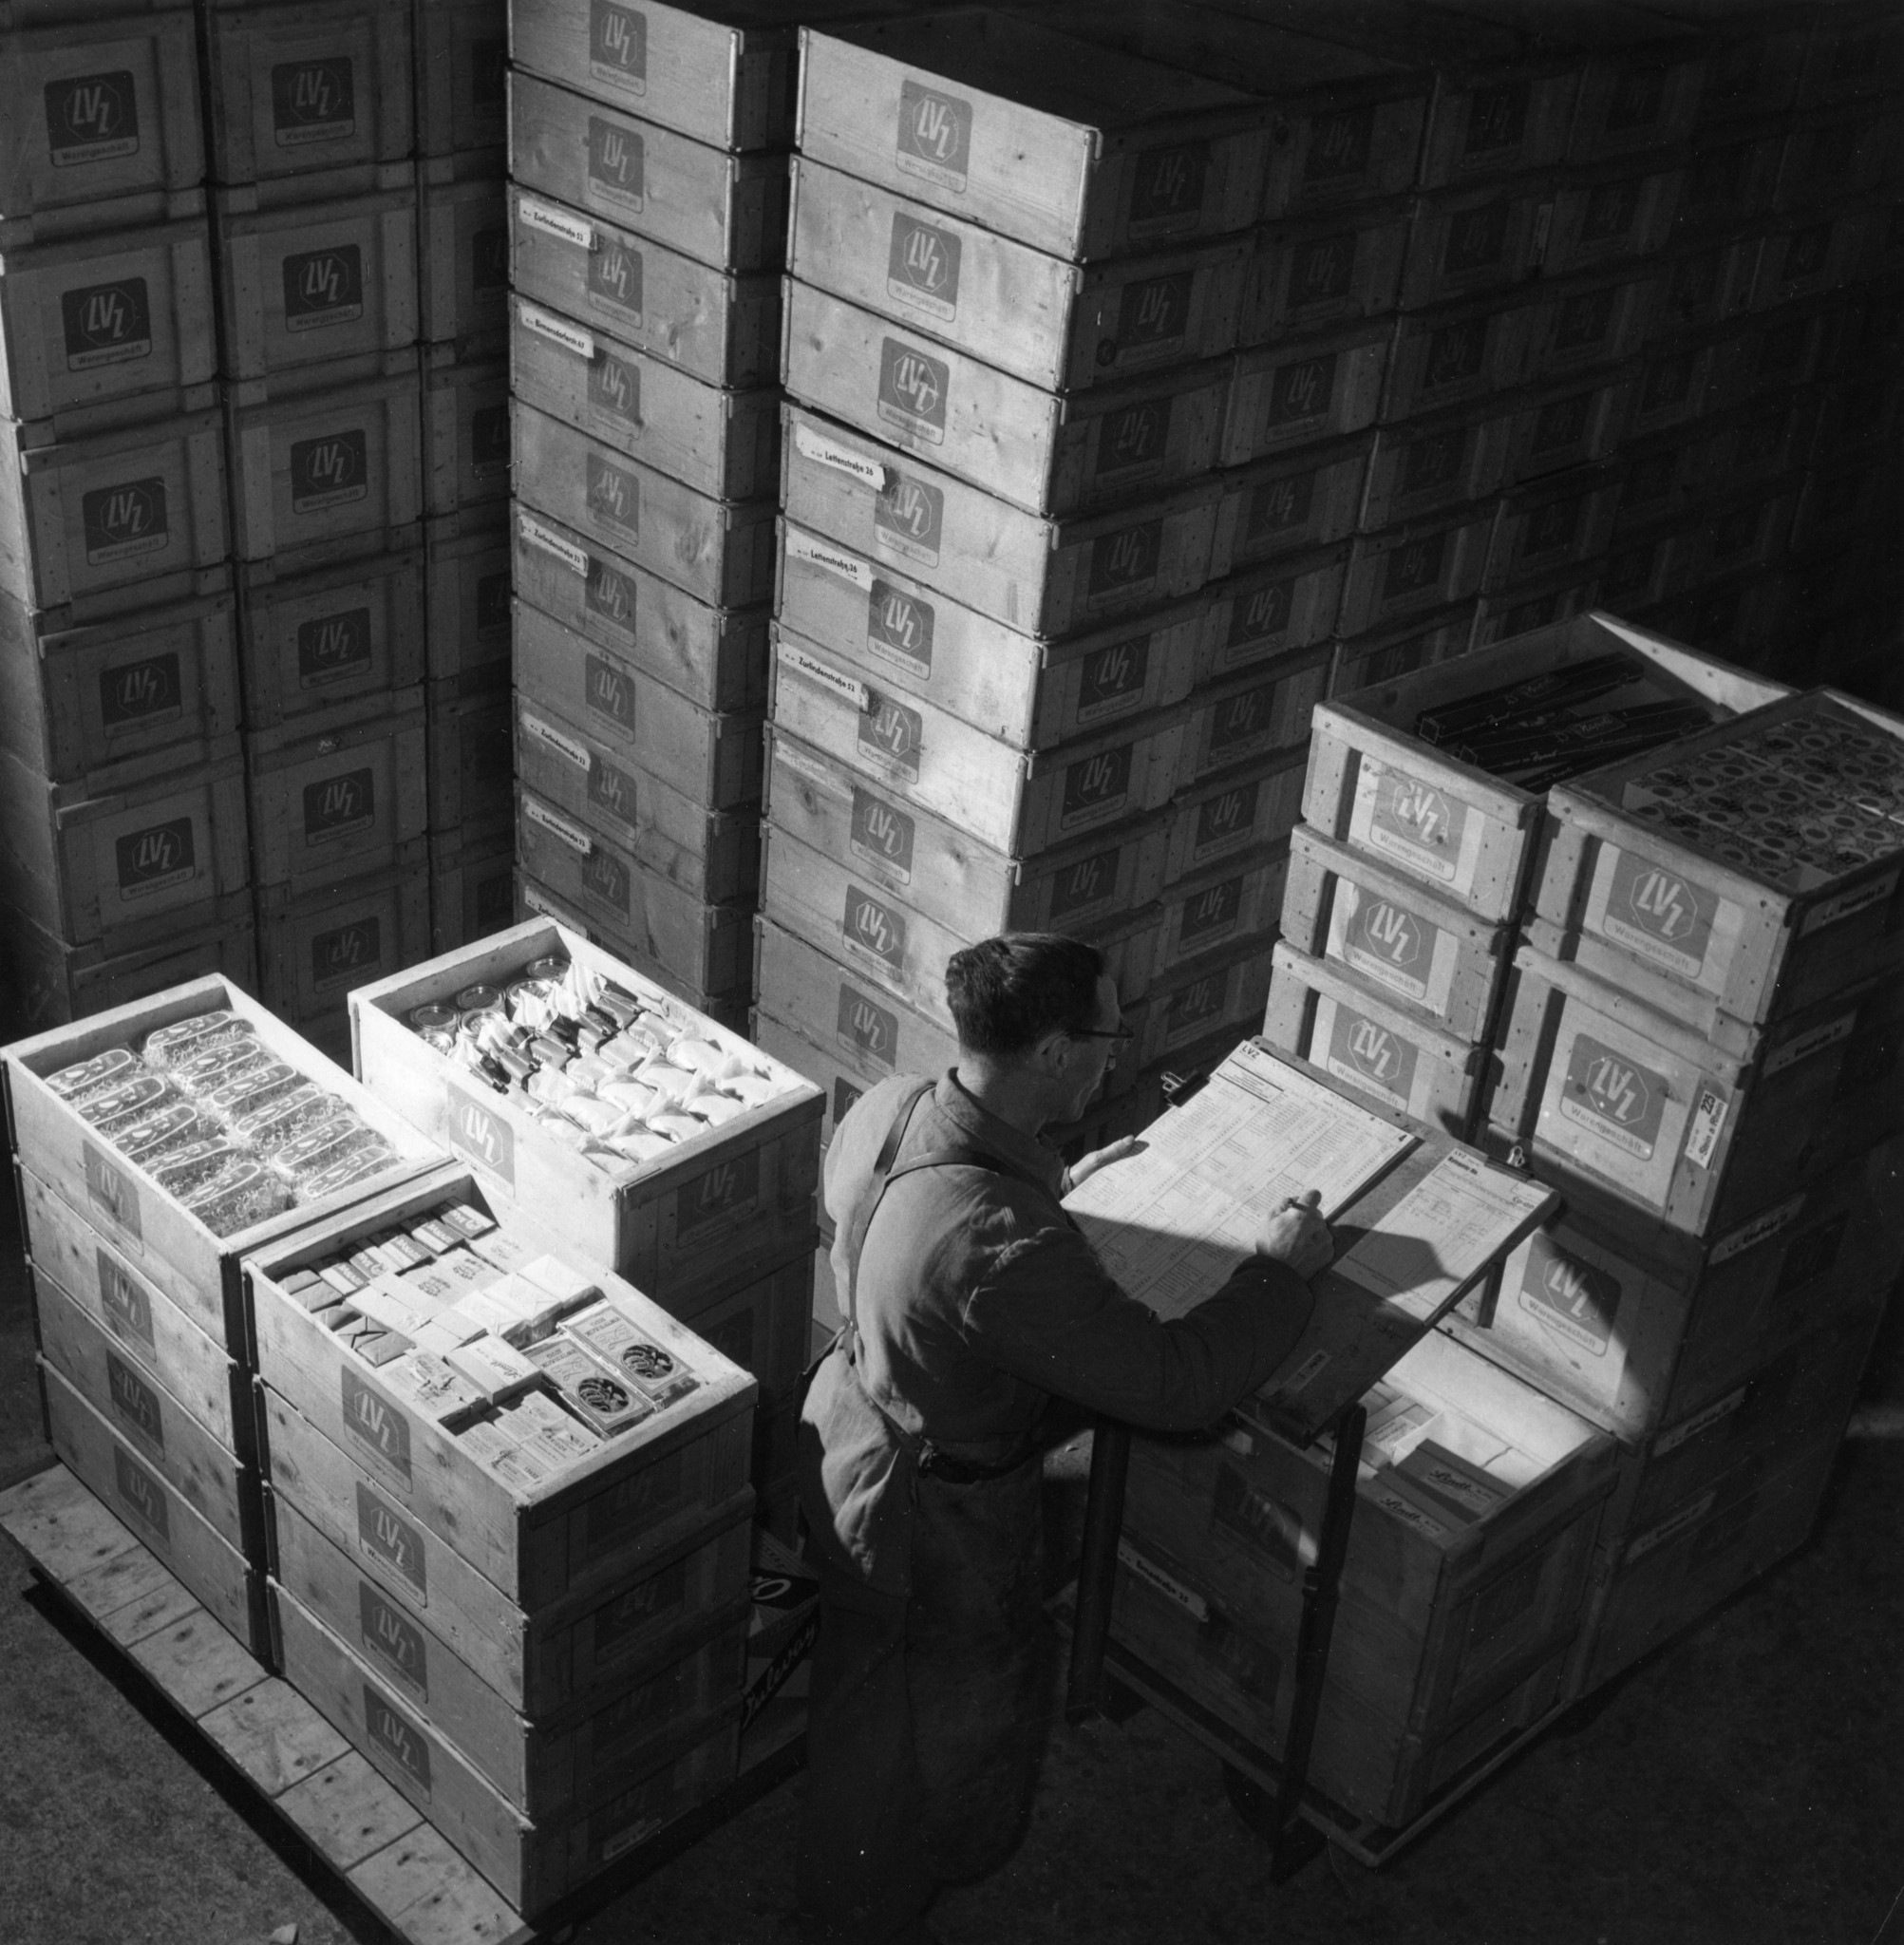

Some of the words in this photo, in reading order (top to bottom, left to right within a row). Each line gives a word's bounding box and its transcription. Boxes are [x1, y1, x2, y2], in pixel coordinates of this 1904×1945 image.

[72, 86, 110, 134] LVZ
[296, 70, 330, 116] LVZ
[918, 100, 949, 158] LVZ
[306, 259, 338, 302] LVZ
[909, 232, 939, 288] LVZ
[88, 293, 123, 338] LVZ
[897, 358, 927, 411] LVZ
[312, 444, 345, 483] LVZ
[825, 451, 863, 473] Lettenstraße
[865, 466, 874, 476] 26
[107, 492, 142, 533] LVZ
[886, 598, 914, 648] LVZ
[799, 656, 846, 688] Zurlindenstraße
[848, 683, 855, 692] 52
[868, 807, 895, 855] LVZ
[1398, 783, 1439, 843] LVZ
[139, 833, 170, 870] LVZ
[1380, 832, 1446, 874] Warengeschäft
[1637, 872, 1684, 937] LVZ
[1371, 904, 1409, 963] LVZ
[1613, 923, 1690, 970] Warengeschäft
[1353, 952, 1416, 991] Warengeschäft
[855, 1003, 879, 1048] LVZ
[1241, 1045, 1260, 1060] LVZ
[1354, 1021, 1393, 1079] LVZ
[1335, 1063, 1400, 1107] Warengeschäft
[1593, 1059, 1635, 1121] LVZ
[1700, 1093, 1716, 1115] 225
[465, 1105, 494, 1164] LVZ
[1572, 1105, 1643, 1153] Warengeschäft
[1549, 1261, 1590, 1318] LVZ
[1529, 1298, 1597, 1349] Warengeschäft
[361, 1393, 389, 1451] LVZ
[1380, 1499, 1421, 1520] Lindt
[377, 1510, 405, 1564] LVZ
[379, 1607, 407, 1662] LVZ
[385, 1710, 410, 1763] LVZ
